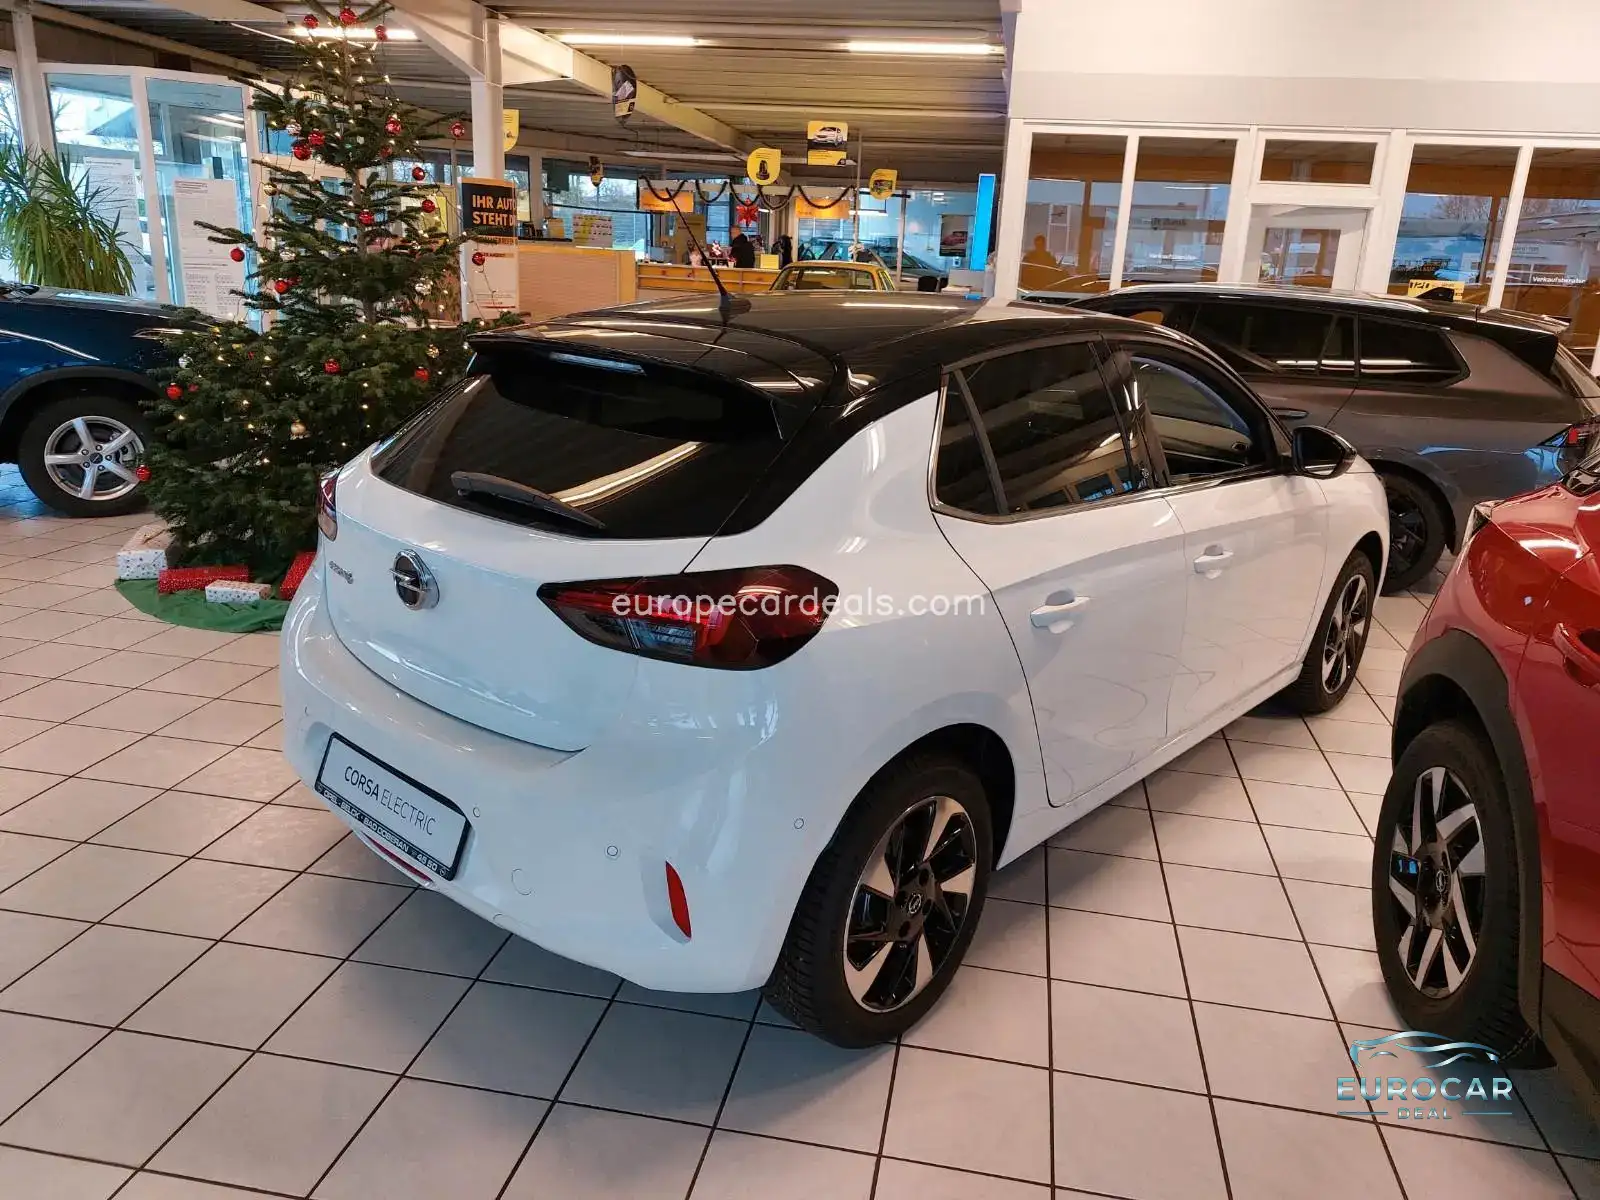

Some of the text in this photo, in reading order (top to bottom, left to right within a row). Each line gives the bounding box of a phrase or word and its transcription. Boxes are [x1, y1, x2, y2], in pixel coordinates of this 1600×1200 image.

[472, 195, 494, 209] IHR
[472, 211, 507, 226] STEHT
[344, 766, 436, 836] CORSA ELECTRIC
[363, 816, 377, 831] BAD
